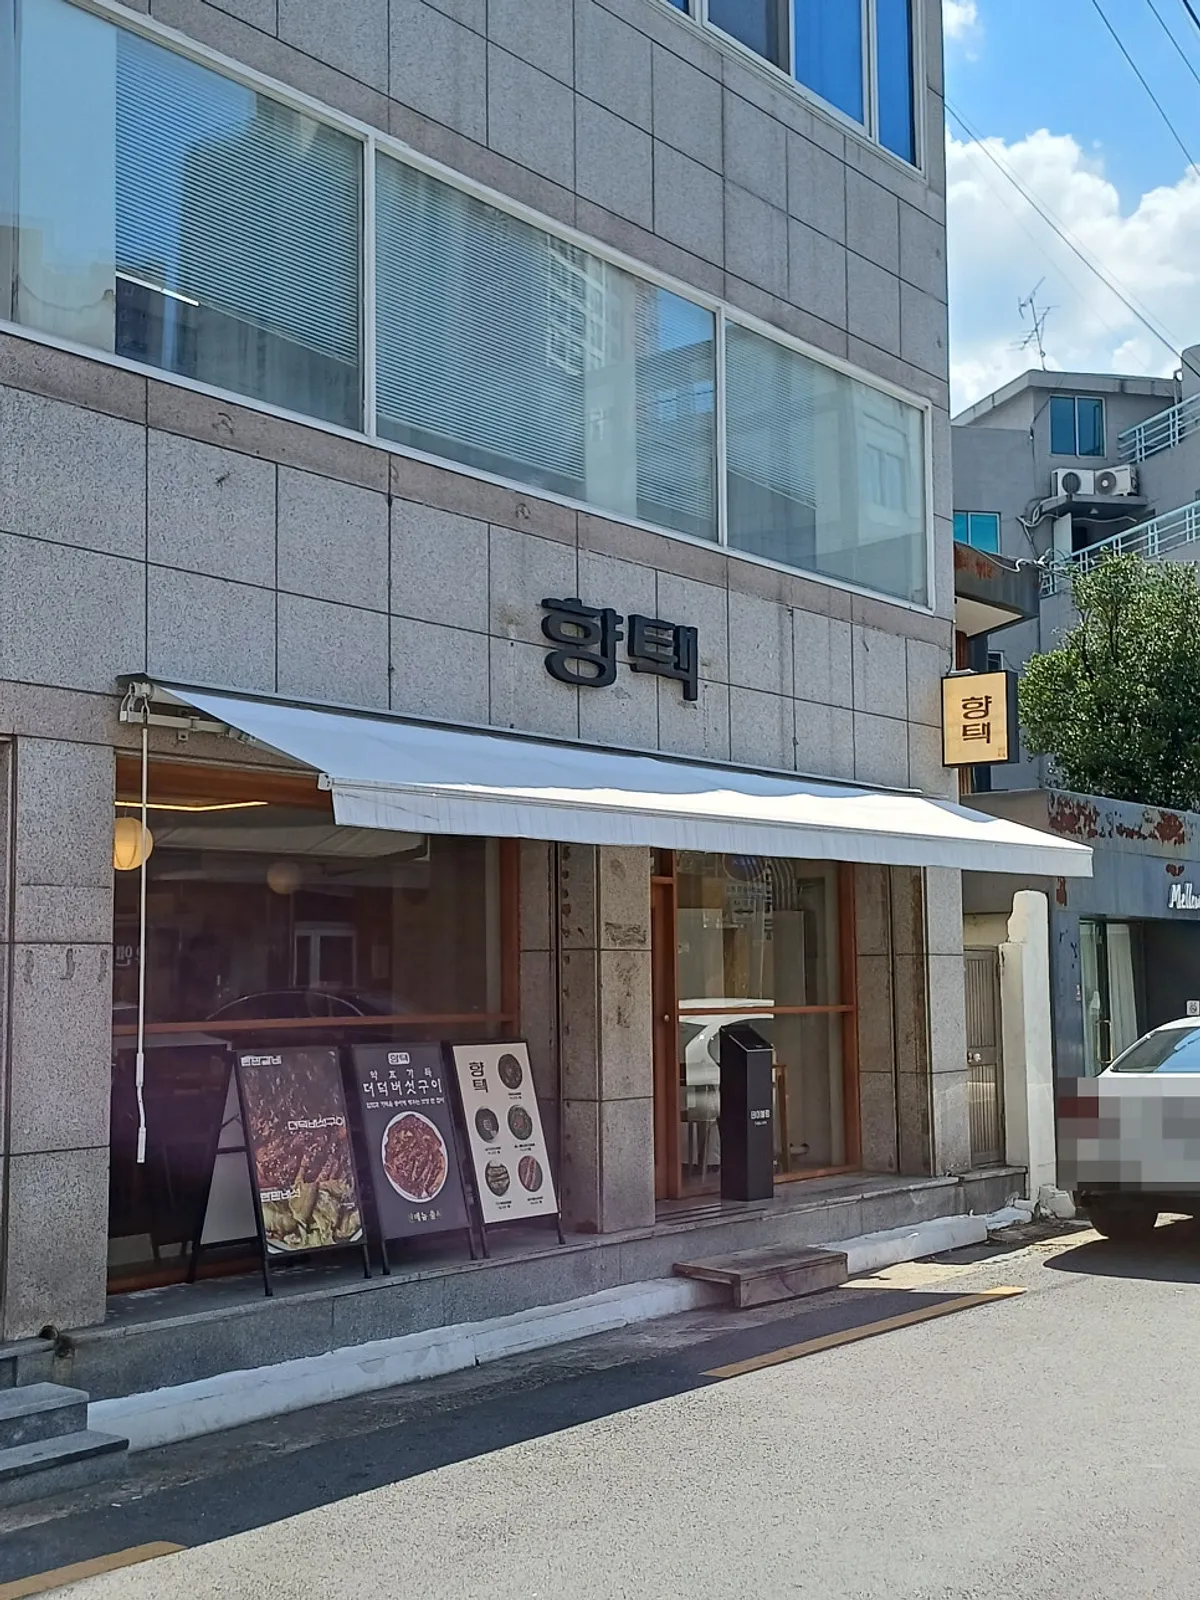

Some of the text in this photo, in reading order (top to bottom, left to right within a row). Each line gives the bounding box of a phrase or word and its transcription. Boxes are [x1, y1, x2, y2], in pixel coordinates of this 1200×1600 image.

[541, 597, 698, 701] 향택
[961, 695, 992, 744] 향택
[362, 1078, 443, 1098] 더덕버섯구이
[469, 1061, 489, 1093] 향택
